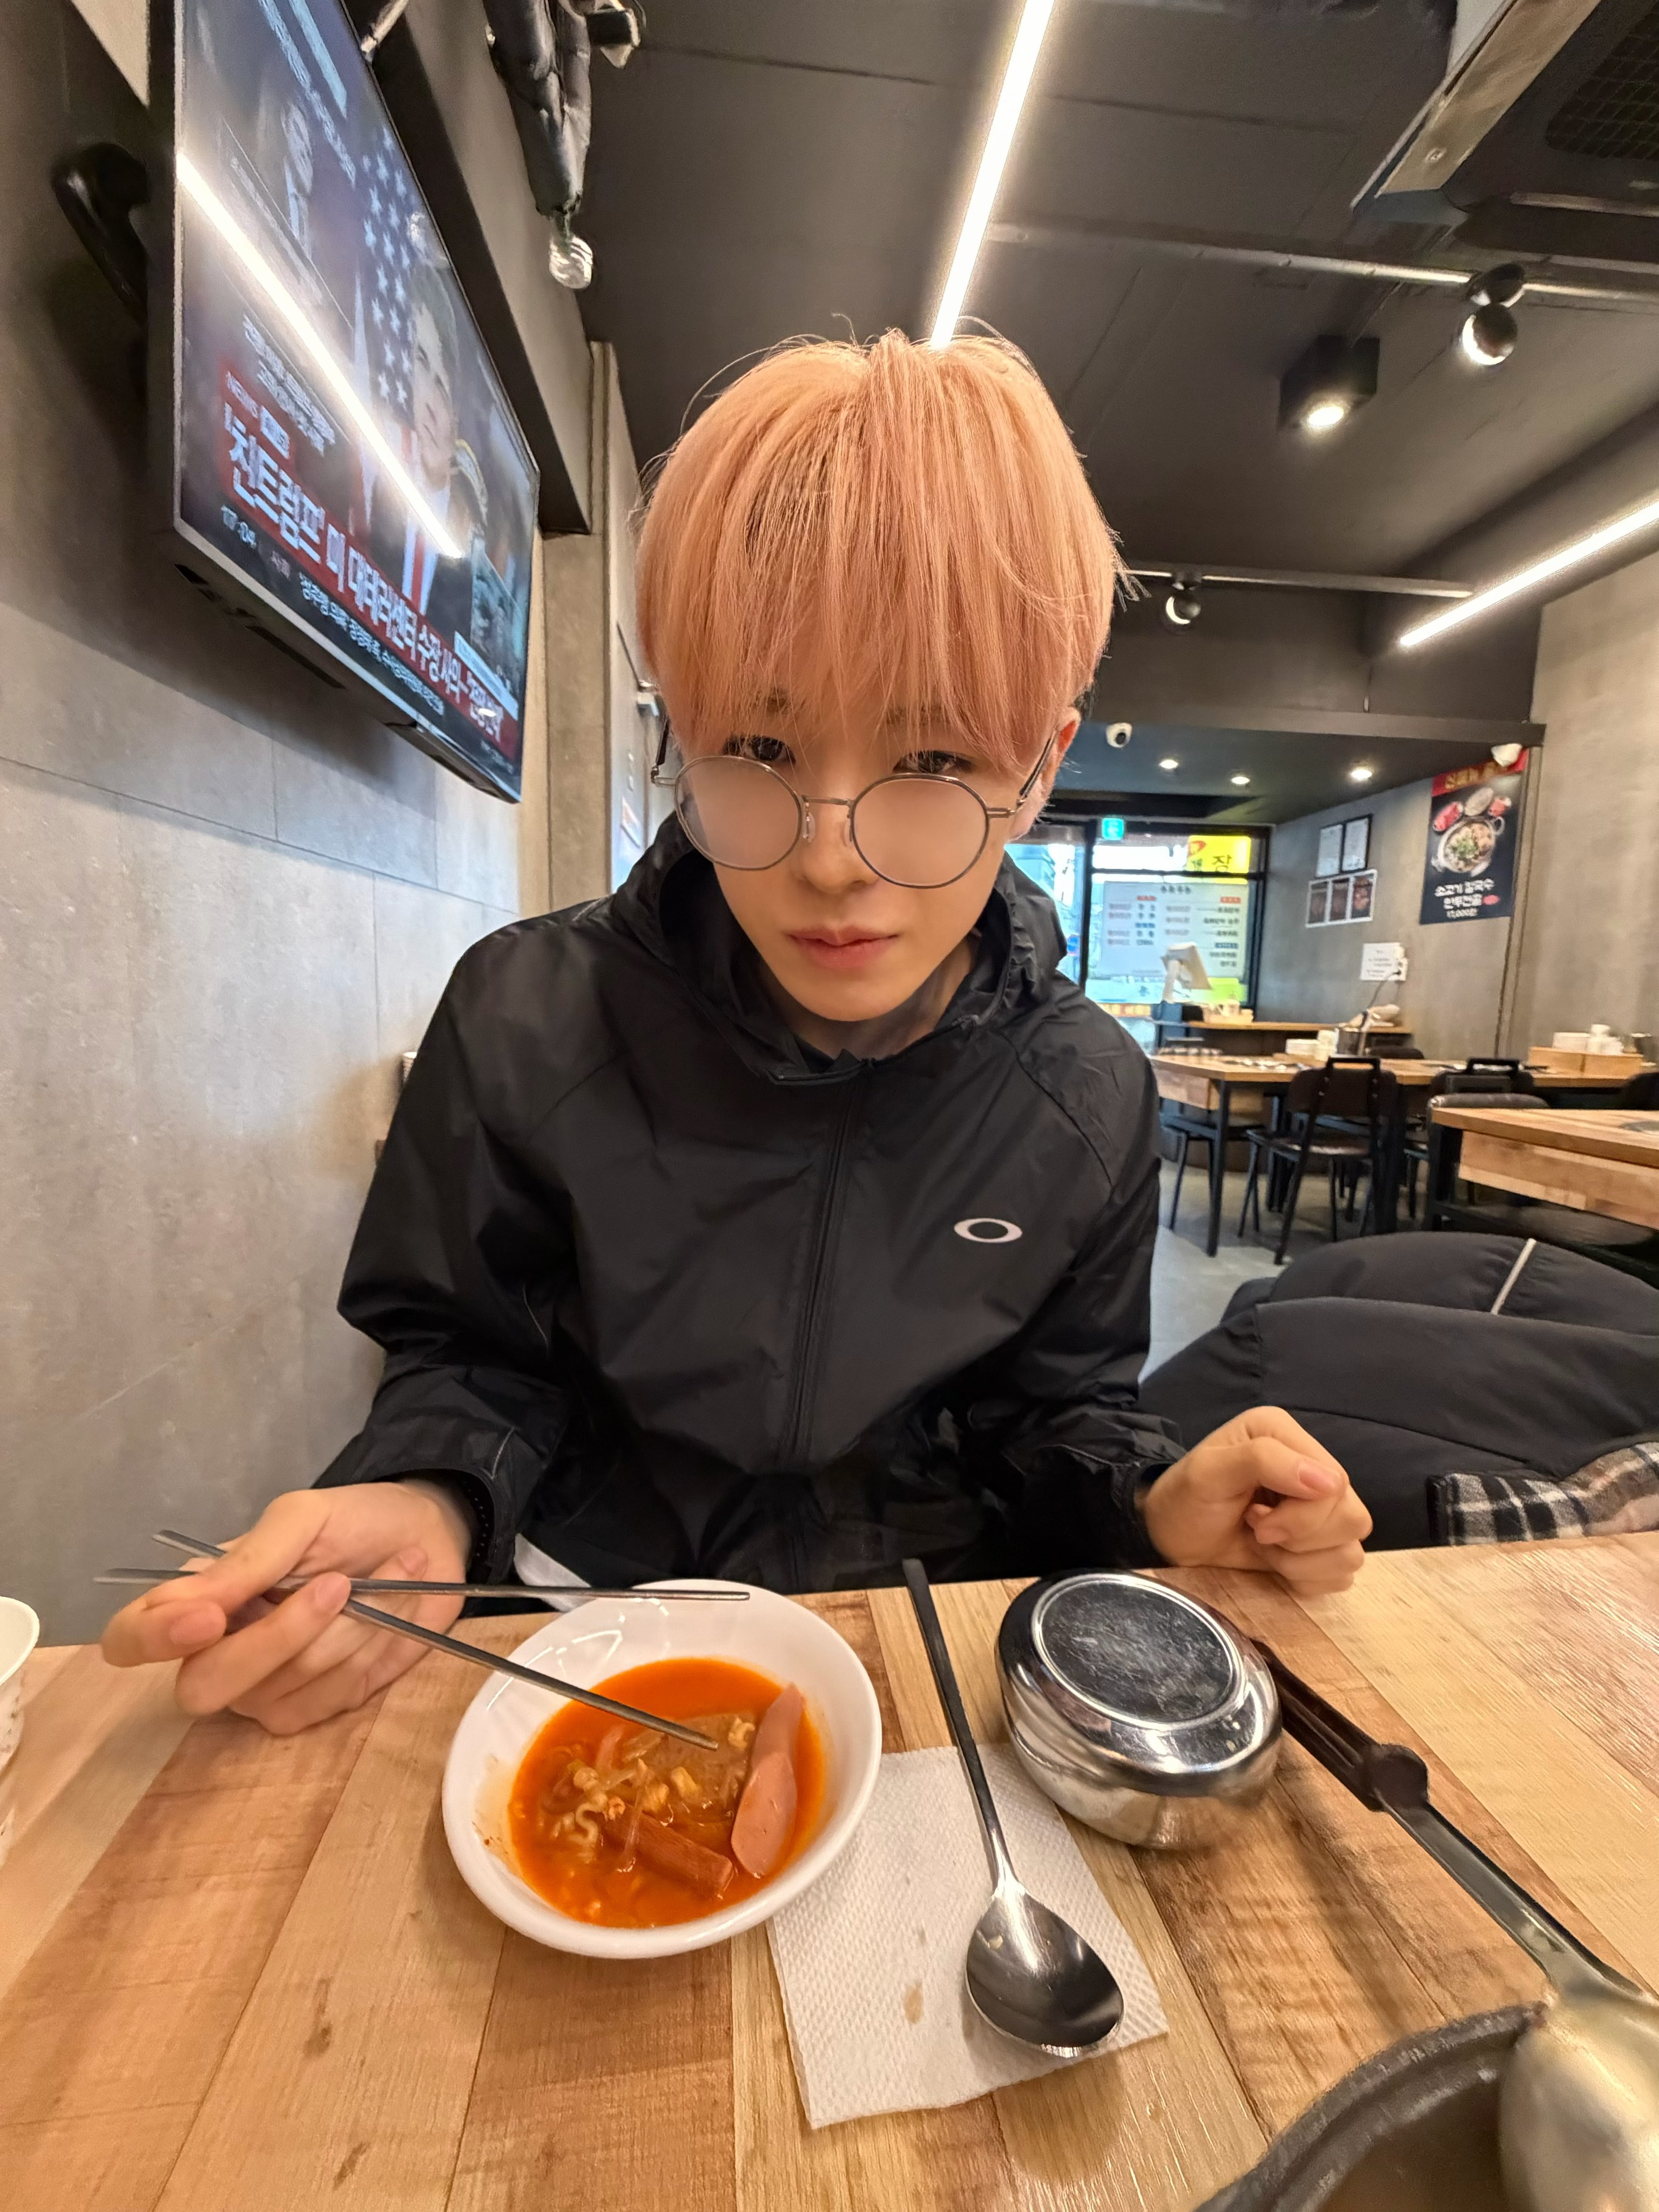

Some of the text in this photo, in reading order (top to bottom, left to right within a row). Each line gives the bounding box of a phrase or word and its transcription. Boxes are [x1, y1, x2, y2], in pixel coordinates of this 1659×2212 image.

[326, 523, 346, 593] 미
[348, 546, 418, 662] 대테러센터
[417, 624, 441, 682] 수장
